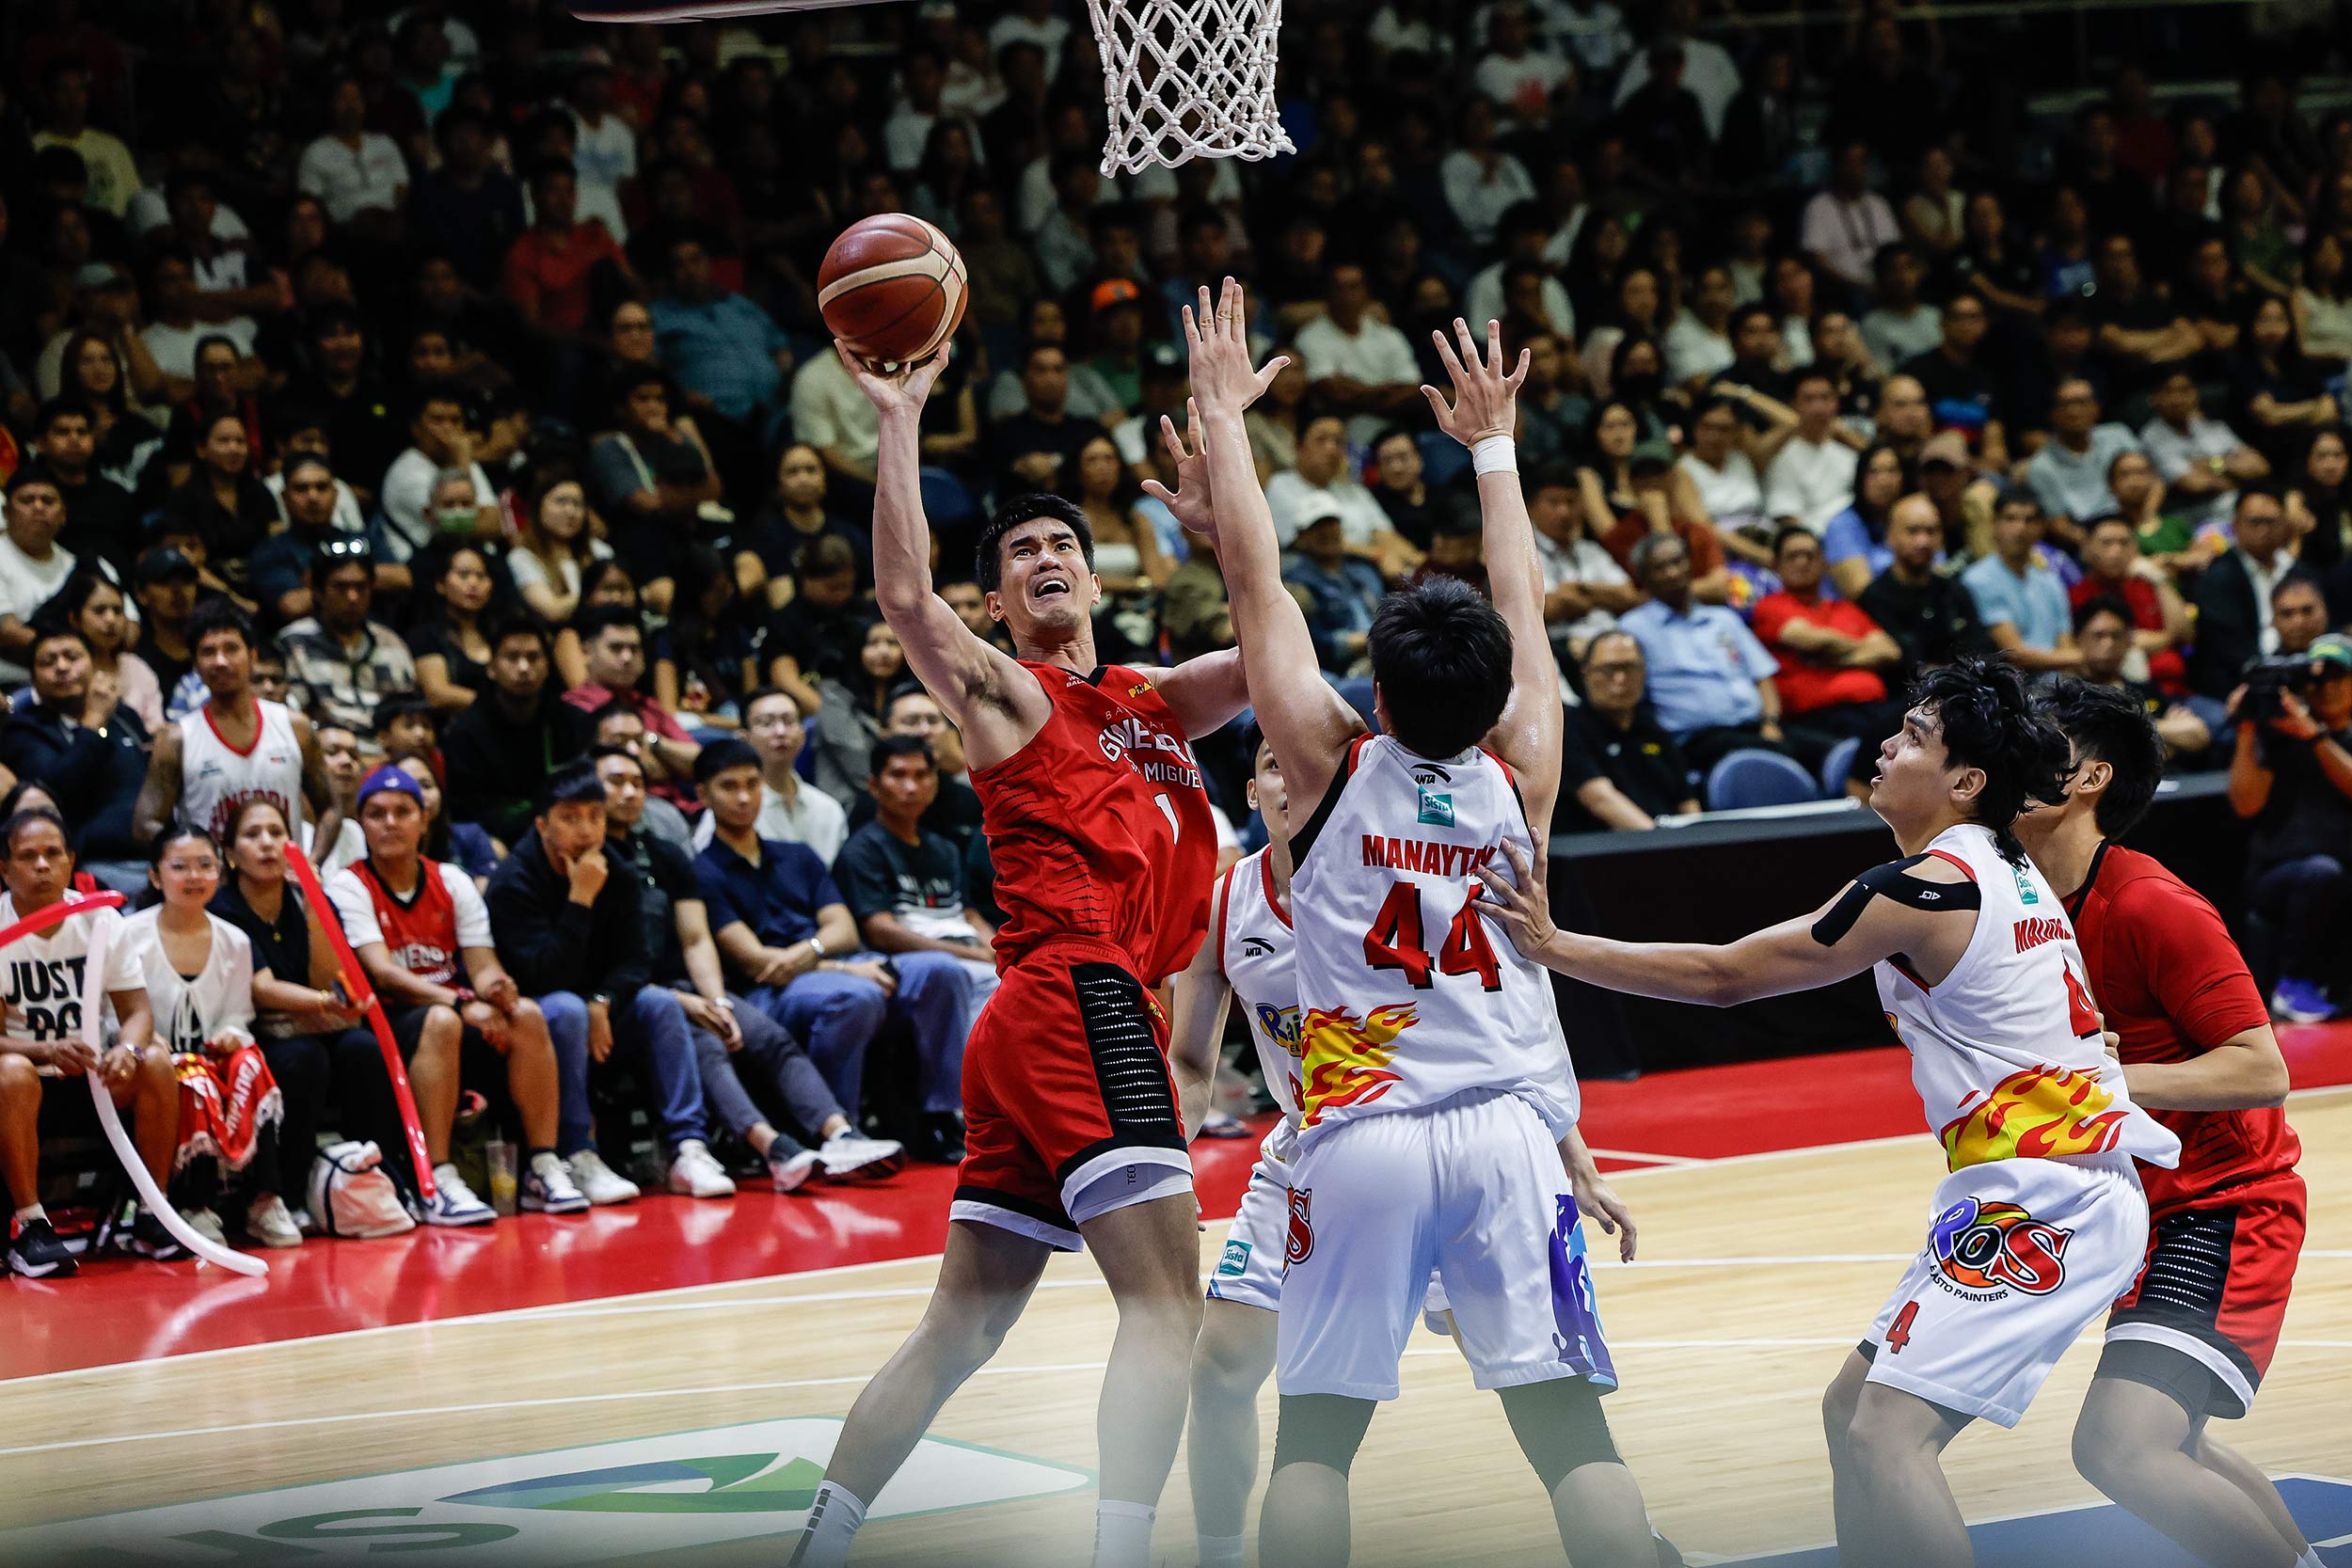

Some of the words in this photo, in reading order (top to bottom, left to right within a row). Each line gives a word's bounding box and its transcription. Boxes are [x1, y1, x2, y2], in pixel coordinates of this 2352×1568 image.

[1415, 774, 1436, 785] ANTA
[1153, 793, 1180, 846] 1
[1245, 946, 1263, 958] ANTA
[1363, 880, 1502, 992] 44
[6, 956, 87, 1005] JUST
[25, 1002, 82, 1041] DO
[1256, 1004, 1301, 1043] Rai
[1127, 1164, 1136, 1185] TEC
[1225, 1248, 1244, 1263] Sista
[1953, 1288, 2009, 1303] PAINTERS
[1885, 1300, 1920, 1354] 4
